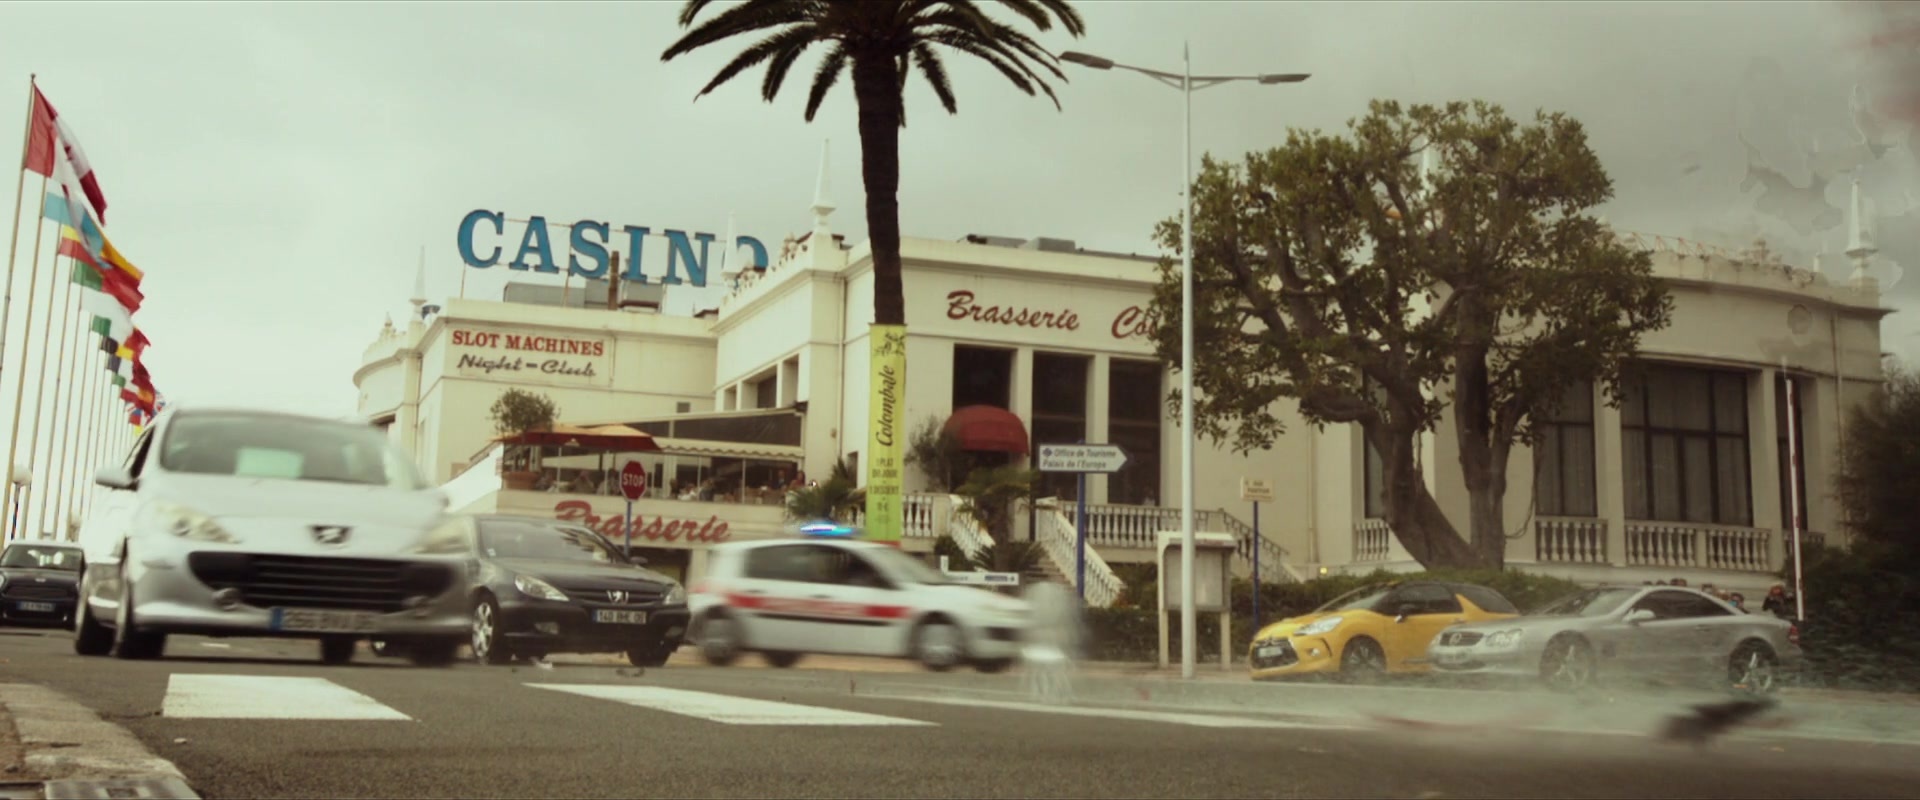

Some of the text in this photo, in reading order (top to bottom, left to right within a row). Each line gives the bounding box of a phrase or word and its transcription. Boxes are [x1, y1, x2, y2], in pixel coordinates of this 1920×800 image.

[946, 290, 1080, 331] Brasserie
[452, 329, 605, 357] SLOT MACHINES
[457, 353, 522, 374] Night
[541, 359, 597, 377] Club
[876, 365, 897, 447] Colombale
[1043, 459, 1065, 468] Palais
[1067, 460, 1076, 468] de
[1054, 448, 1117, 459] Office de Tourisme
[623, 473, 644, 487] STOP
